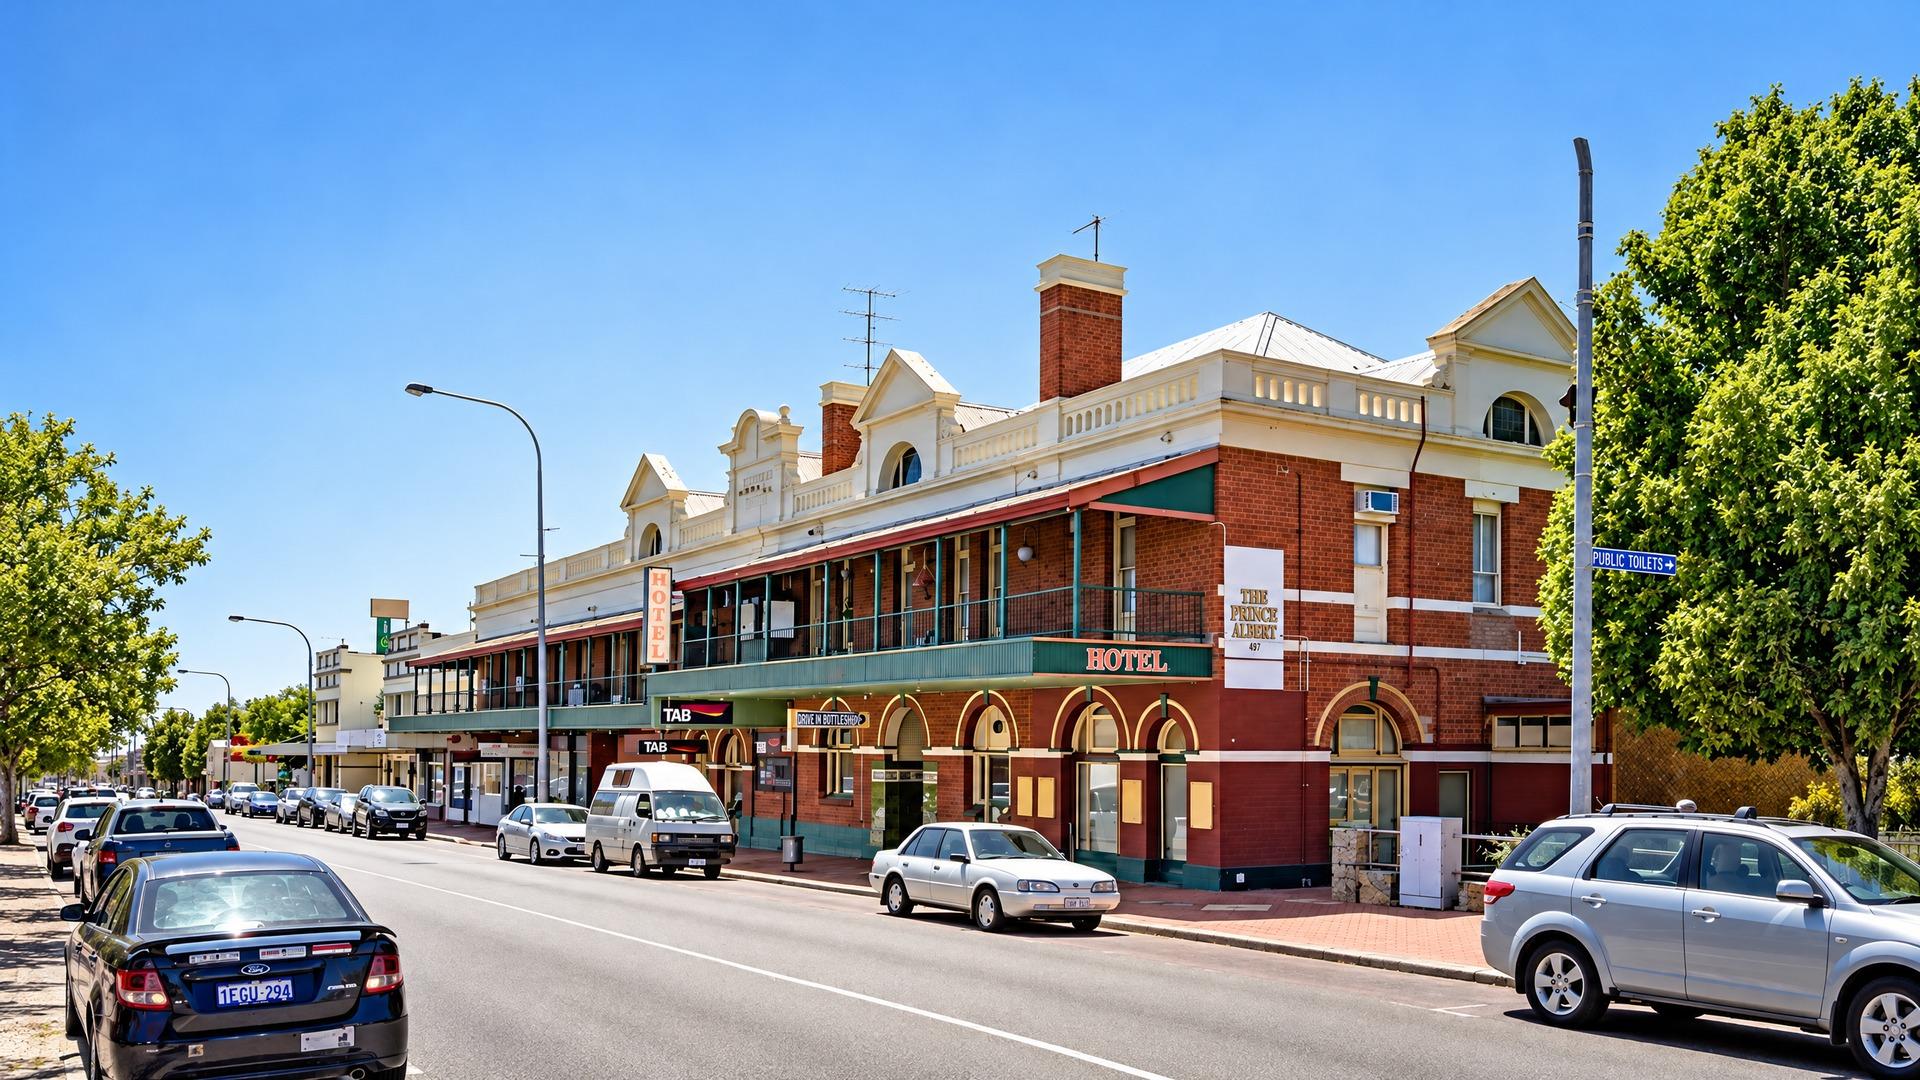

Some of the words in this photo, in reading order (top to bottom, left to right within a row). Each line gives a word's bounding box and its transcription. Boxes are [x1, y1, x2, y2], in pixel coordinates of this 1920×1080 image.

[1593, 551, 1625, 567] PUBLIC
[1628, 554, 1663, 571] TOILETS
[1240, 588, 1268, 605] THE
[651, 572, 667, 659] HOTEL
[1230, 604, 1278, 623] PRINCE
[1231, 622, 1277, 639] ALBERT
[1249, 642, 1261, 652] 497
[1086, 647, 1168, 672] HOTEL
[663, 708, 692, 722] TAB
[797, 713, 815, 725] DRIVE
[815, 713, 822, 725] IN
[644, 741, 668, 753] TAB
[219, 984, 291, 1005] 1EGU-294
